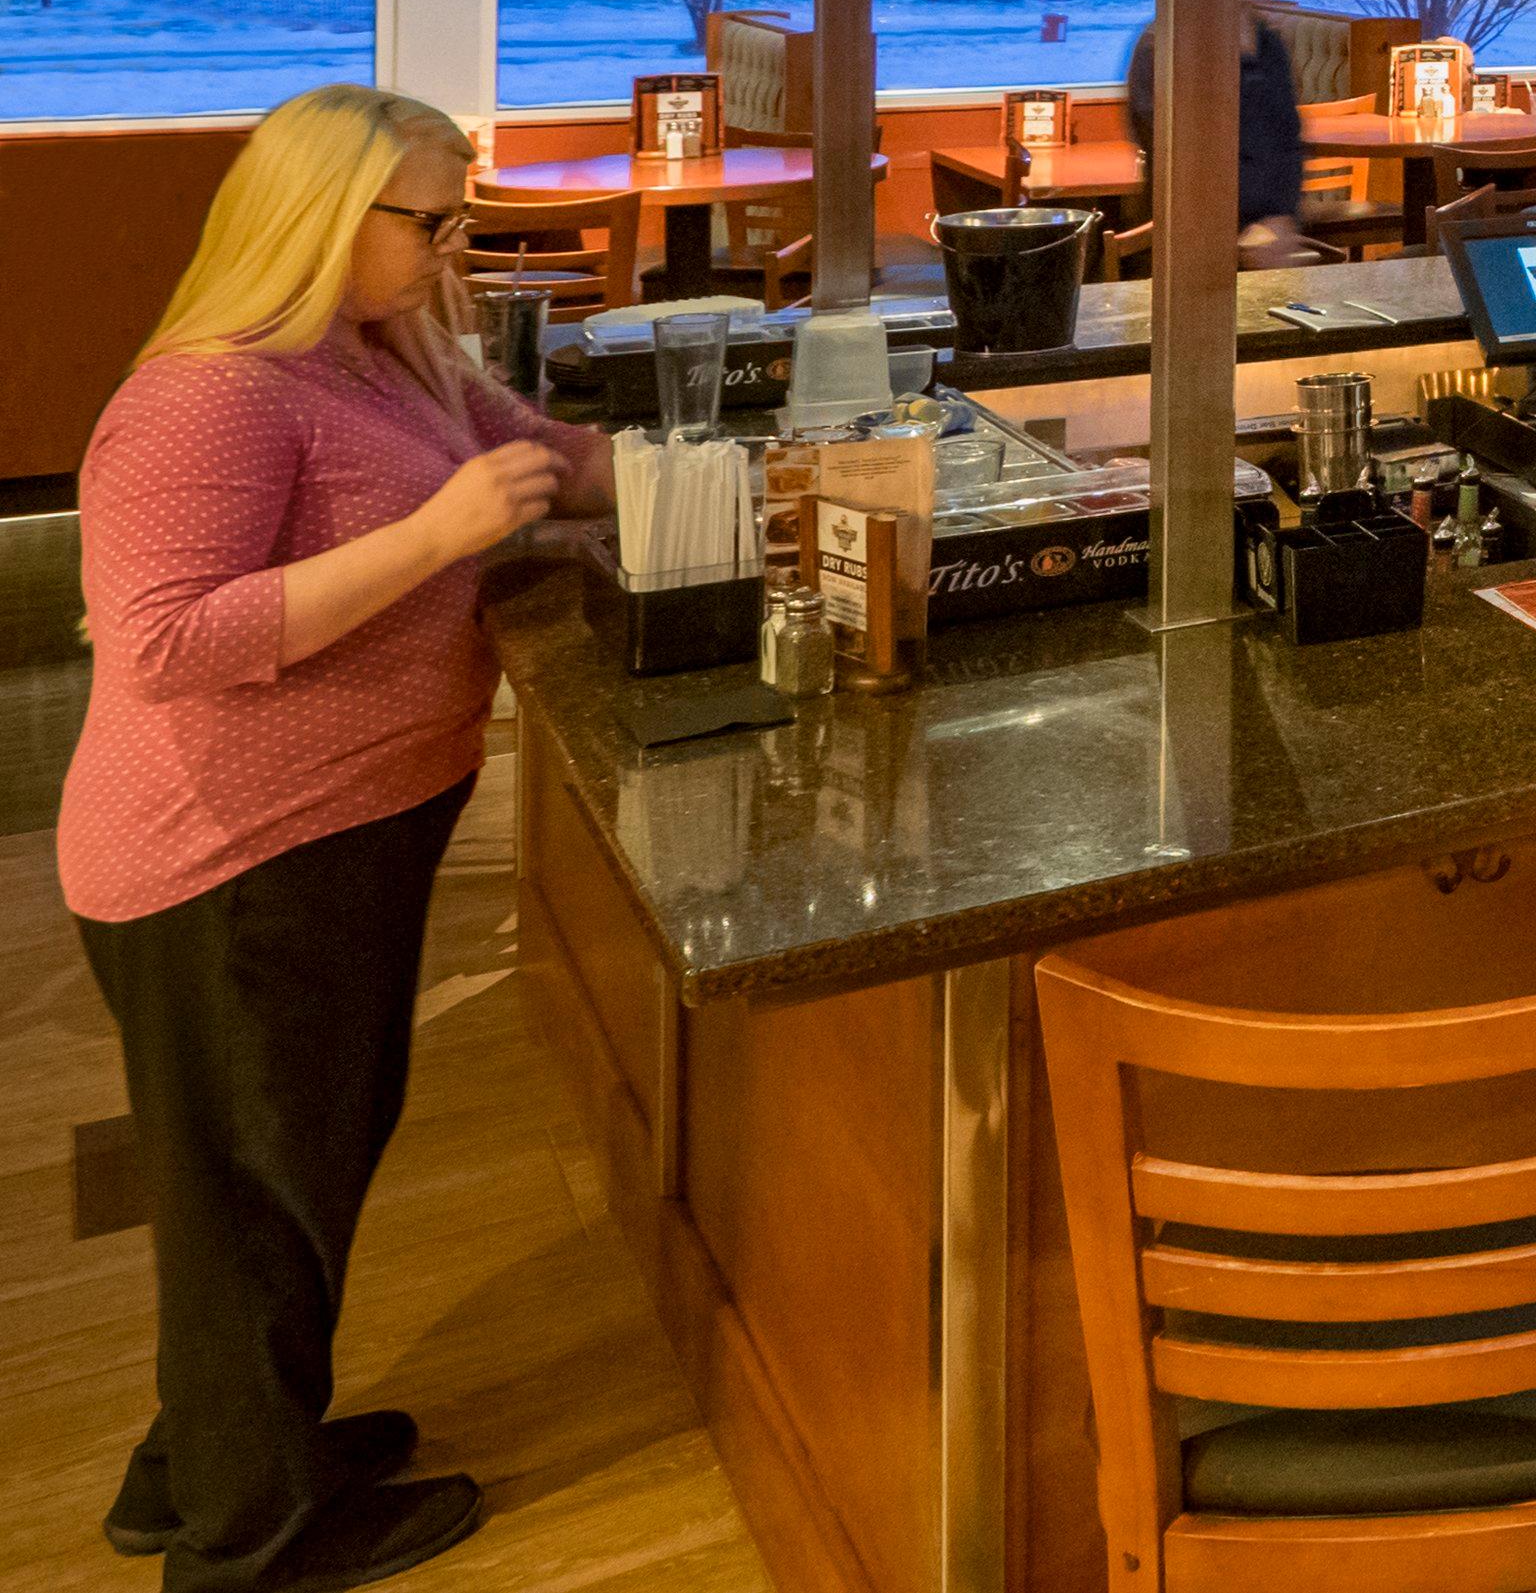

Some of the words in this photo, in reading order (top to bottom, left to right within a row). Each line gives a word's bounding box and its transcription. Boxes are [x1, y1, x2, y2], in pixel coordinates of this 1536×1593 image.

[1081, 536, 1151, 560] Handma
[822, 554, 842, 573] DRY
[843, 557, 867, 580] RUBS
[928, 553, 1025, 596] Tito's
